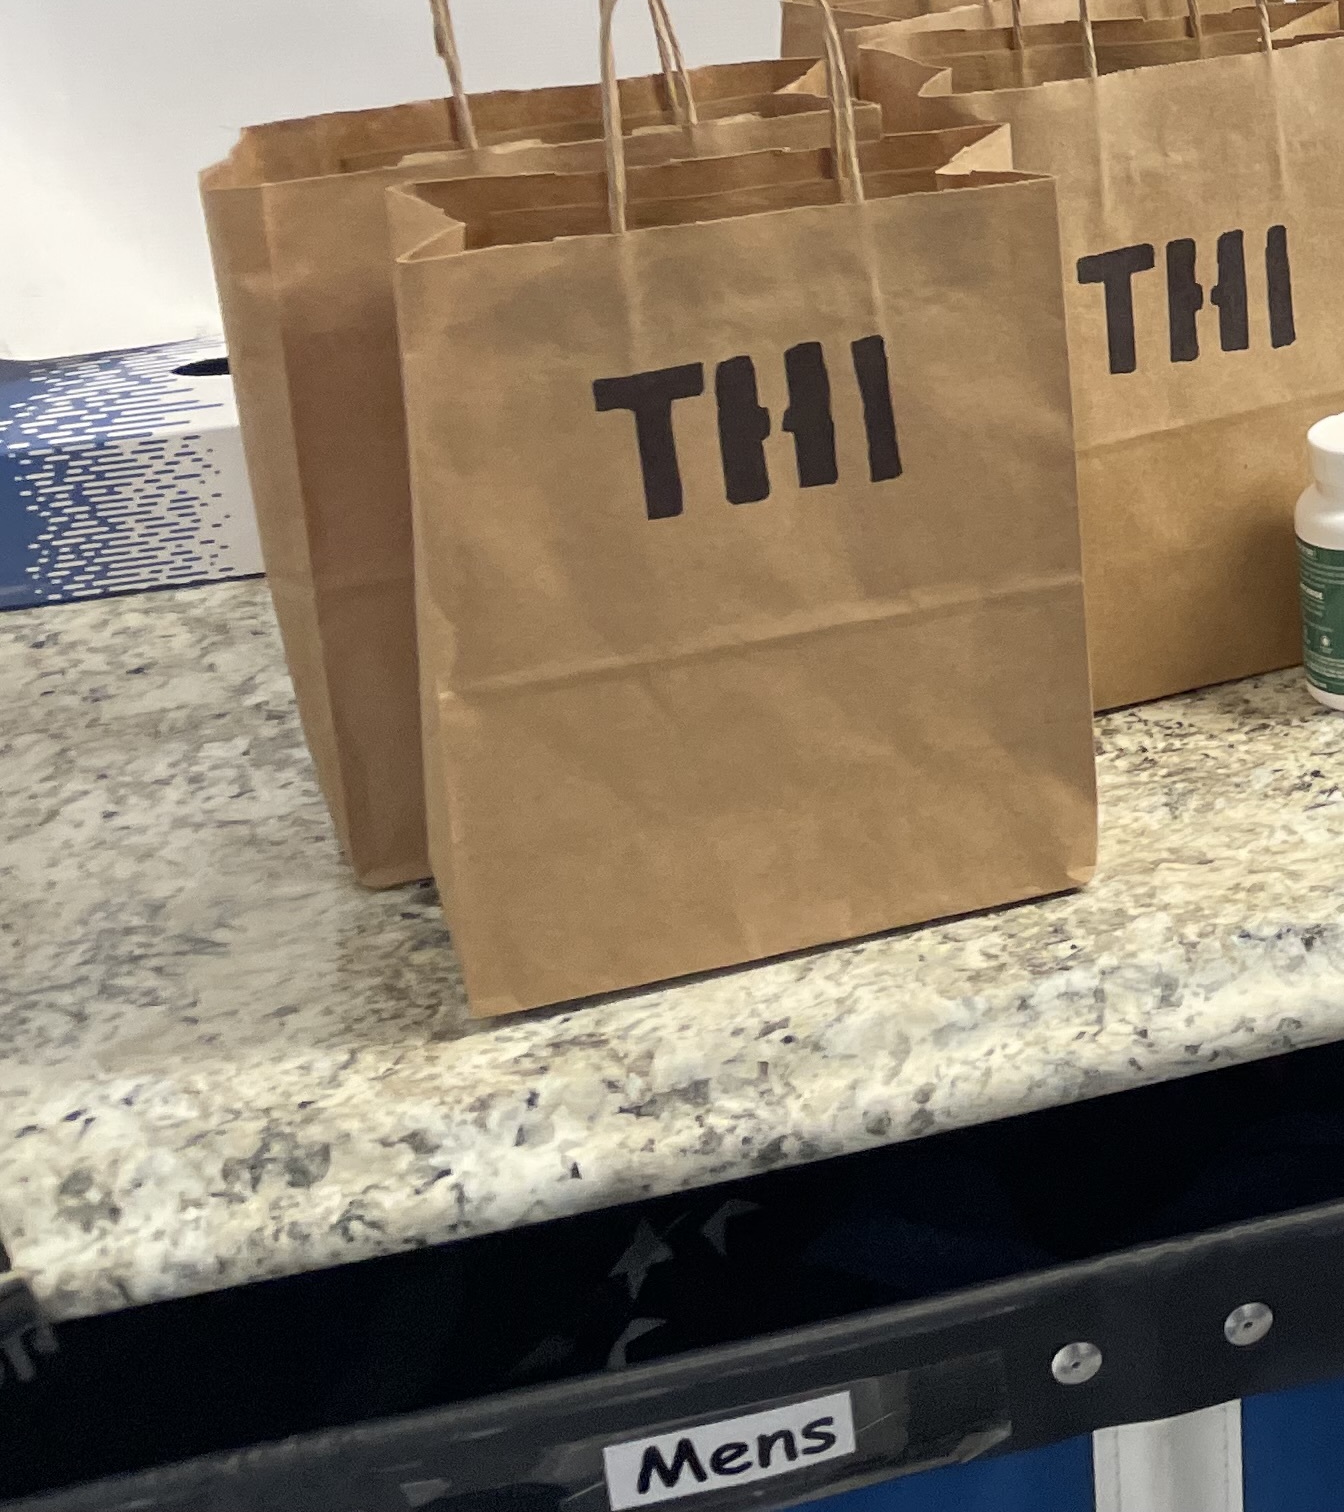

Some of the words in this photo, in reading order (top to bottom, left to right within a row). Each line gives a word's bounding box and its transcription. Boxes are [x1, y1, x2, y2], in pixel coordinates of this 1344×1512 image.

[1076, 224, 1297, 375] THI
[591, 334, 903, 521] THI
[637, 1416, 837, 1495] Mens
